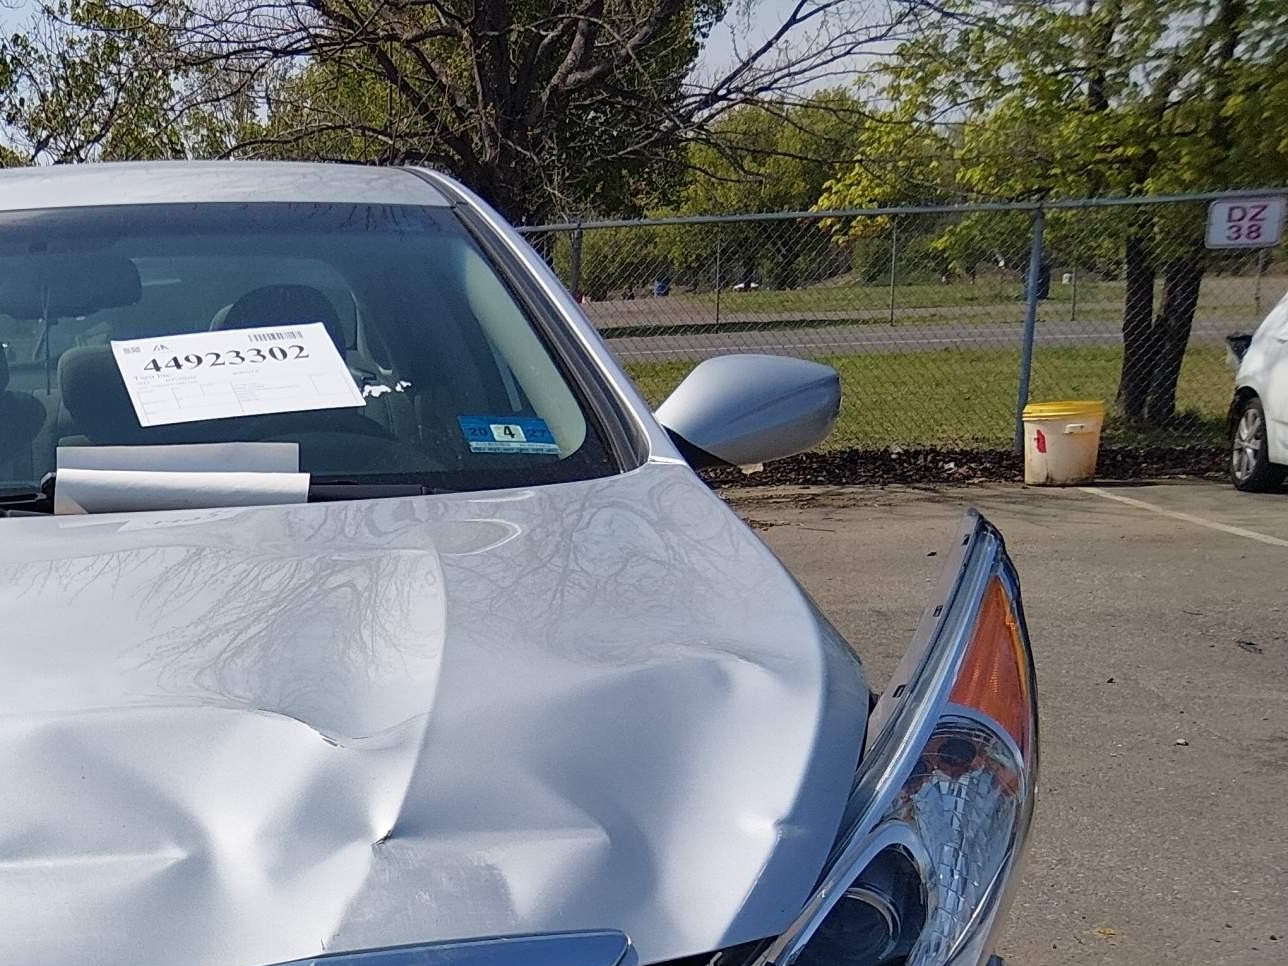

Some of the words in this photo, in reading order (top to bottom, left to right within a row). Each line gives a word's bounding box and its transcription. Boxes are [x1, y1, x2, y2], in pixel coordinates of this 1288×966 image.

[1227, 205, 1268, 223] DZ
[1226, 224, 1261, 241] 38
[143, 344, 310, 372] 44923302
[503, 425, 515, 439] 4
